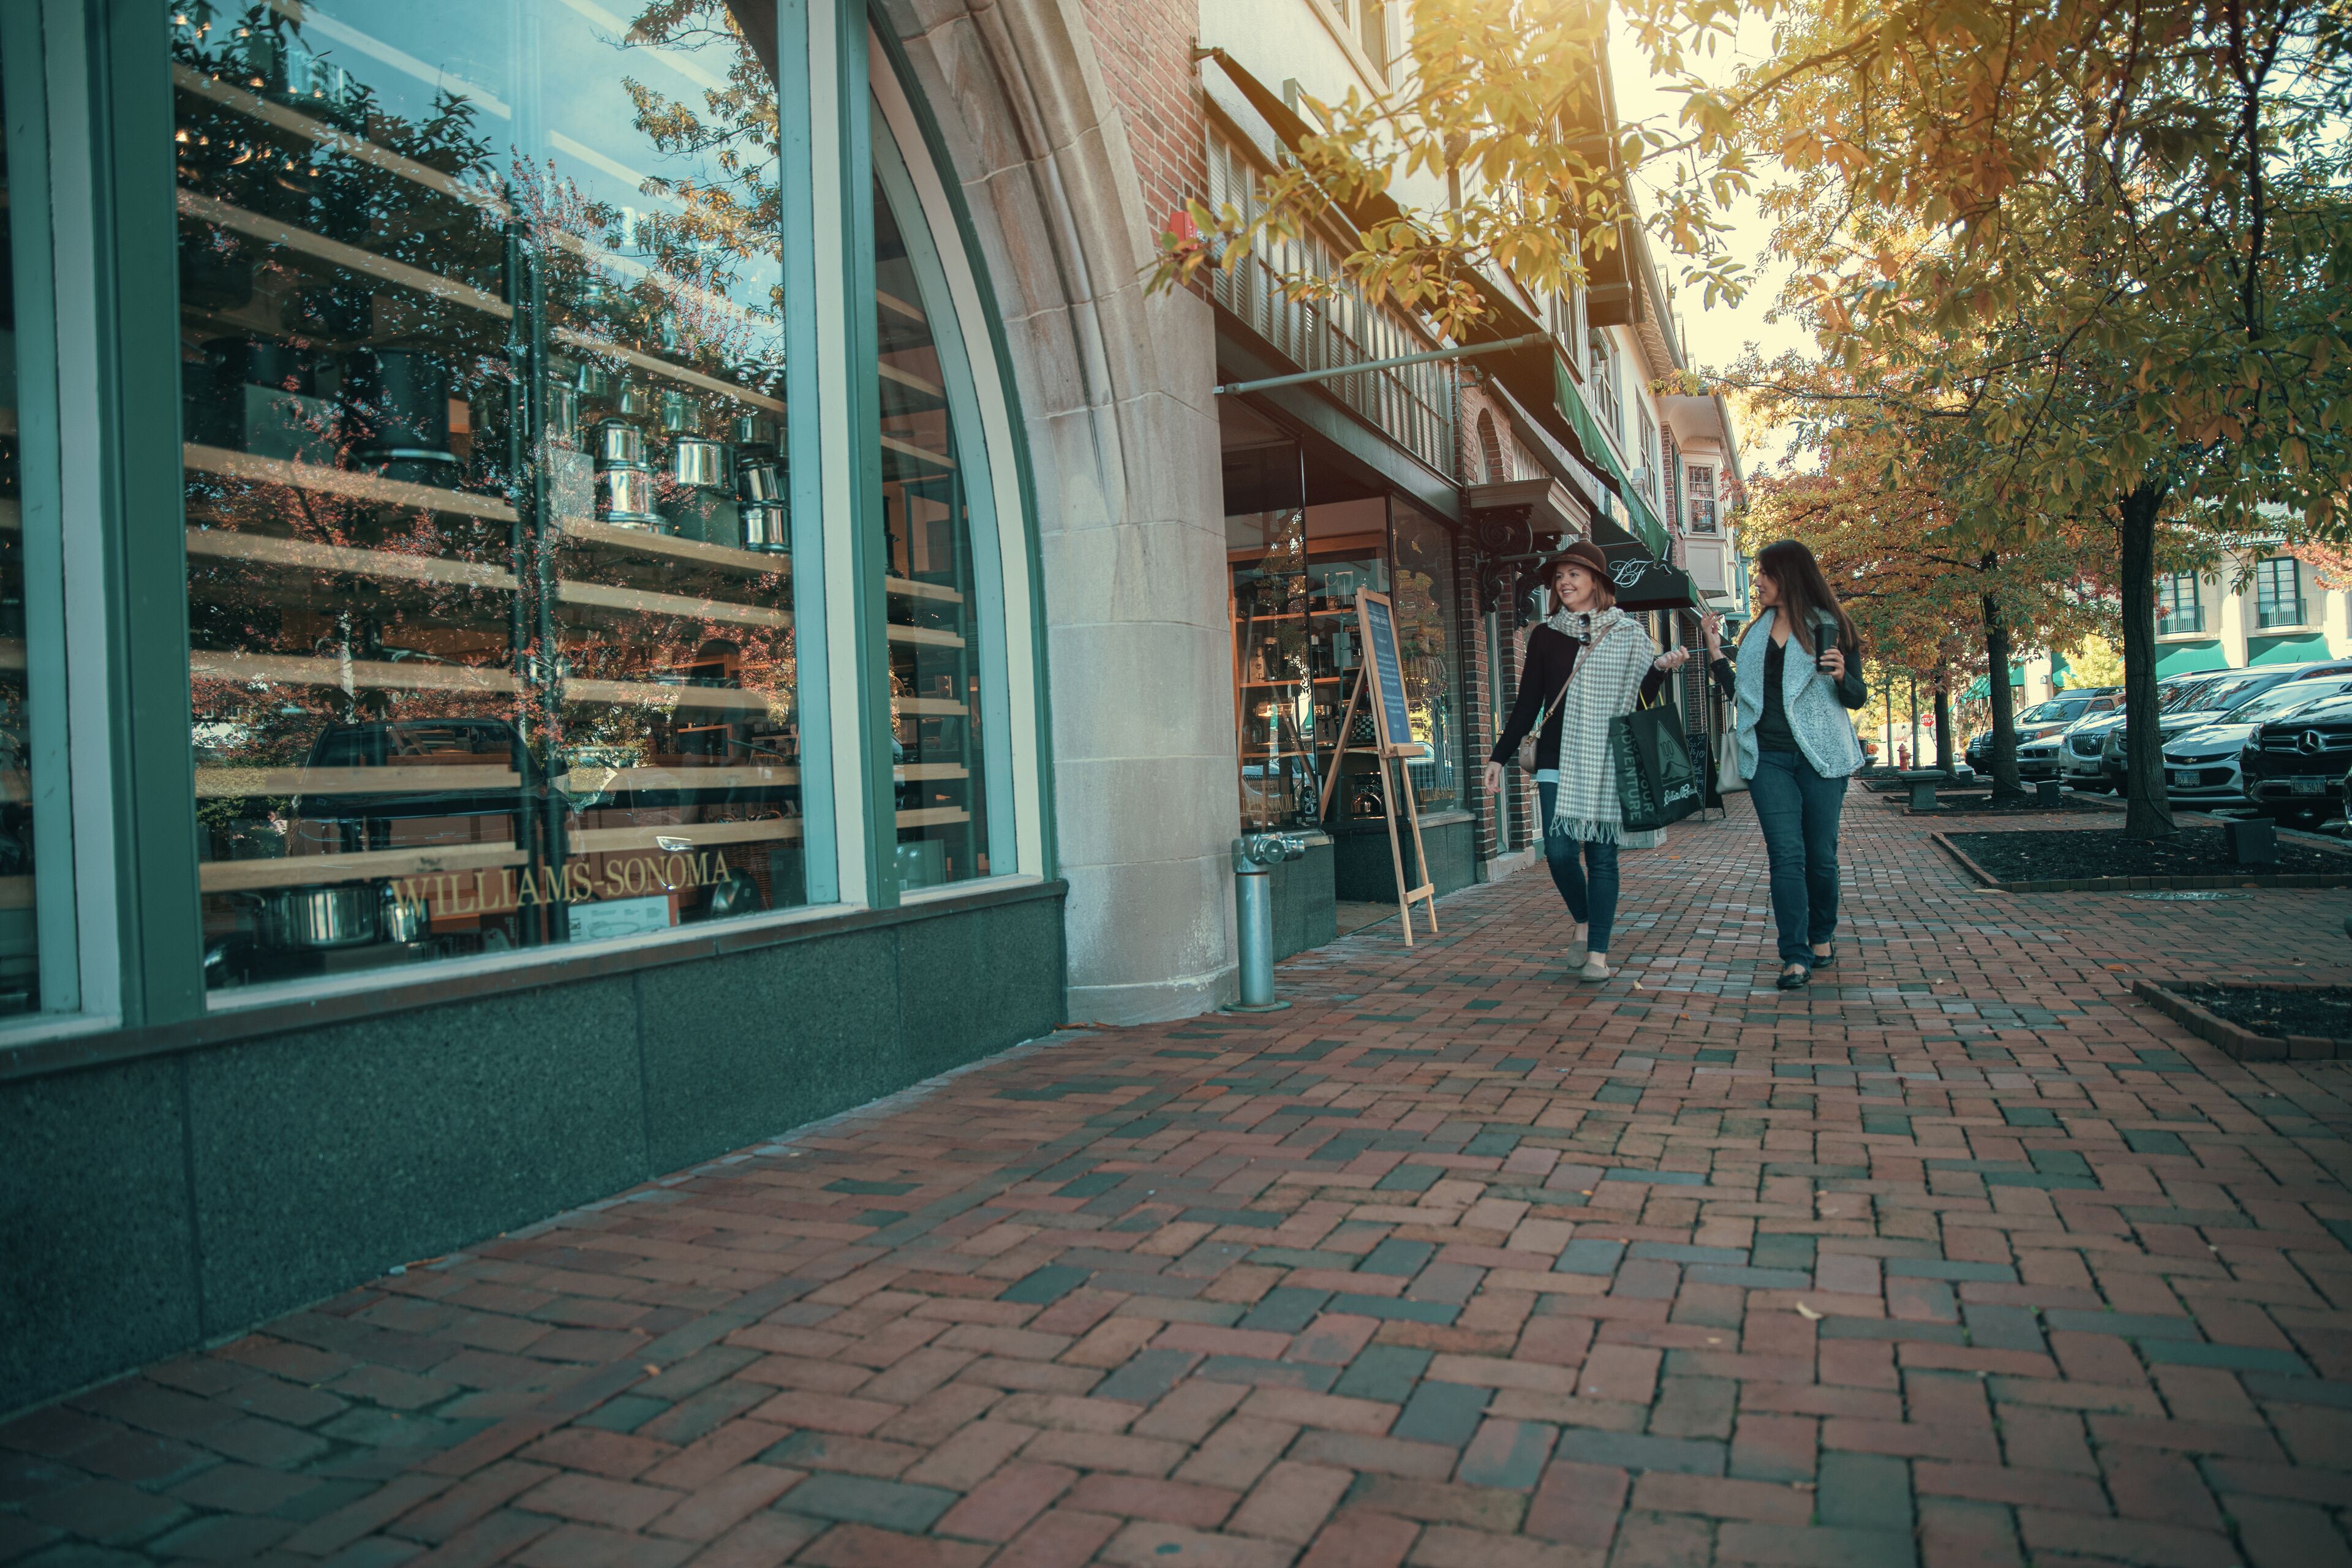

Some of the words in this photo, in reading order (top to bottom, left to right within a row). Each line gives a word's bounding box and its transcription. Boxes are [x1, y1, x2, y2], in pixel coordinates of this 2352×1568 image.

[1619, 723, 1642, 821] ADVENTURE
[1660, 741, 1674, 757] 100
[1639, 769, 1654, 812] YOUR
[388, 850, 732, 918] WILLIAMS-SONOMA
